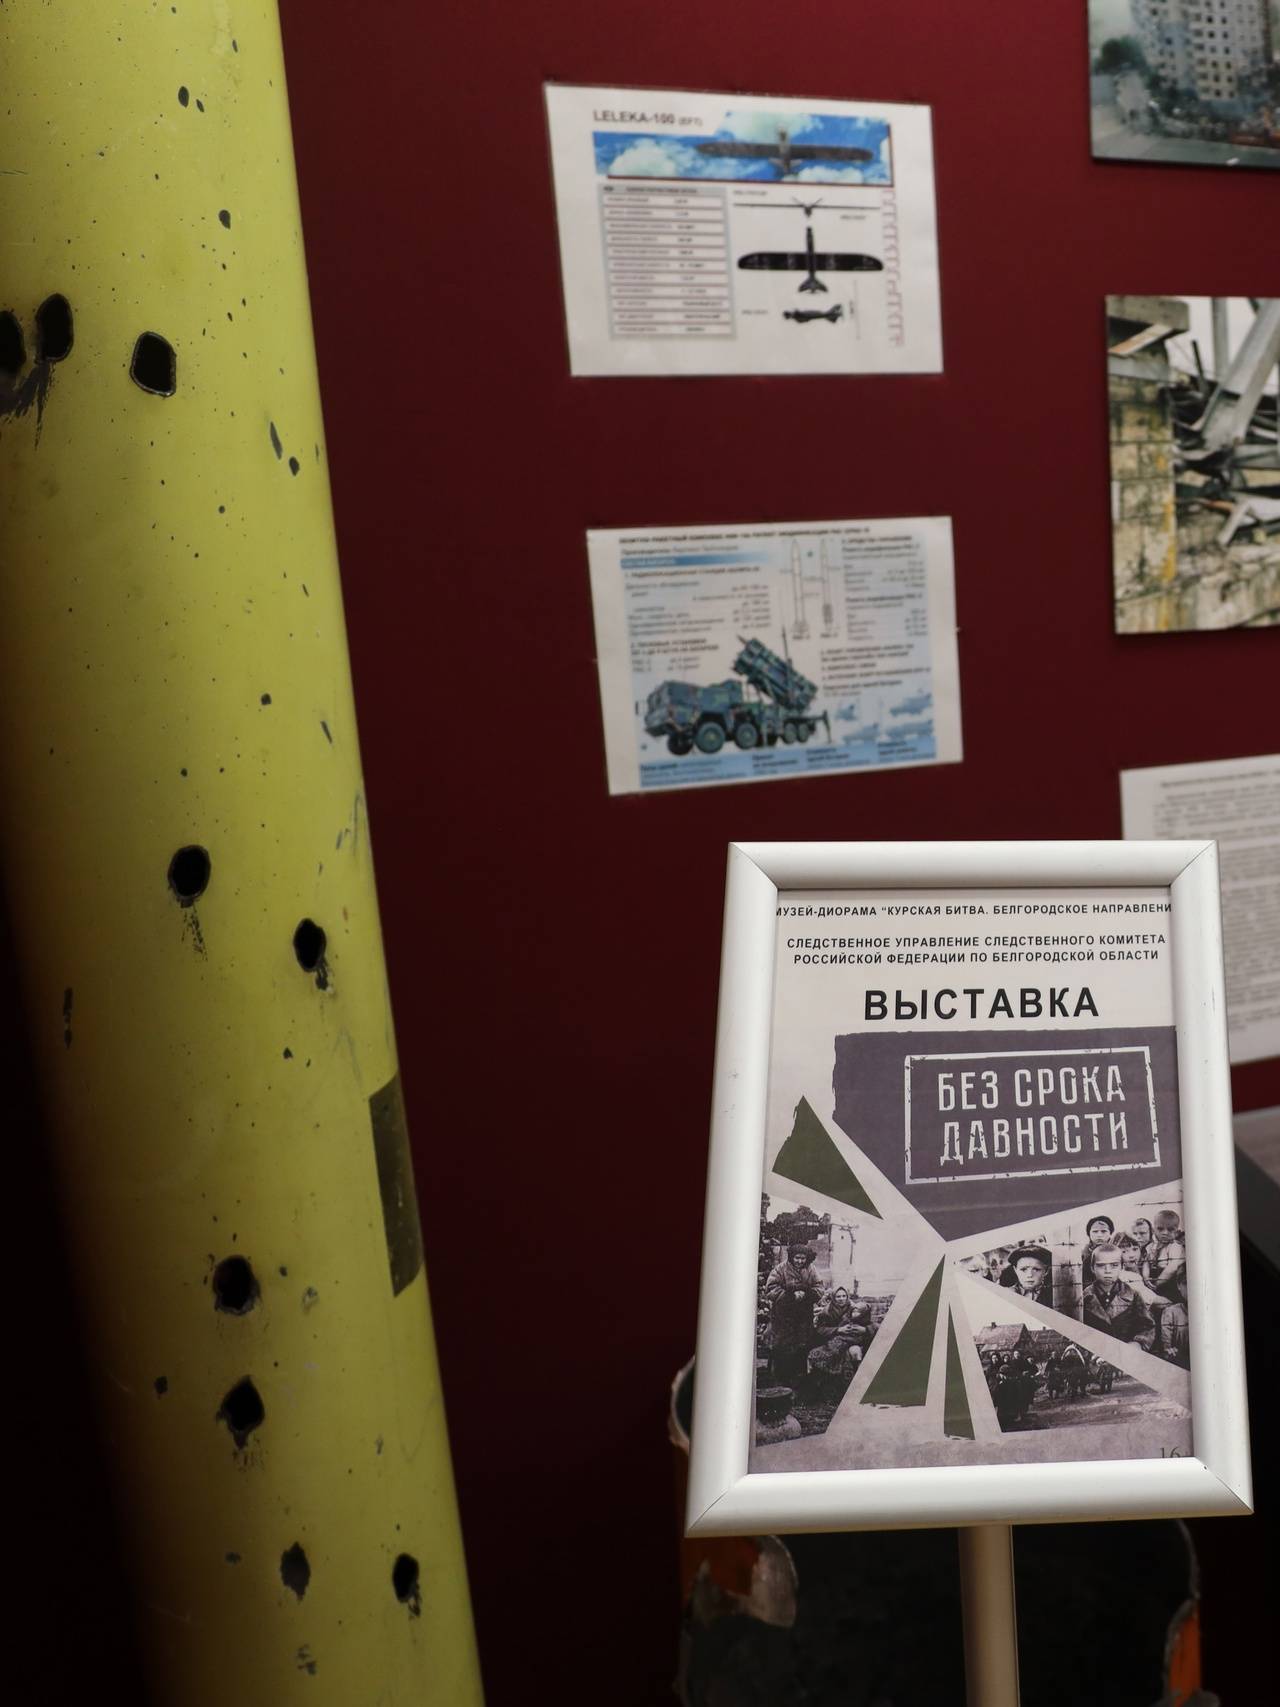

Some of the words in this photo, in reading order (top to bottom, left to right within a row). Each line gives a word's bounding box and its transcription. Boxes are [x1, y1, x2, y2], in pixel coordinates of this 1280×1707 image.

[593, 110, 674, 125] LELEKA-100
[945, 905, 988, 915] БИТВА.
[993, 904, 1088, 916] БЕЛГОРОДСКОЕ
[1092, 903, 1171, 913] НАПРАВЛЕНИ
[787, 937, 890, 950] СЛЕДСТВЕННОЕ
[895, 936, 979, 948] УПРАВЛЕНИЕ
[984, 935, 1095, 948] СЛЕДСТВЕННОГО
[1099, 934, 1166, 945] КОМИТЕТА
[794, 951, 882, 965] РОССИЙСКОЙ
[886, 952, 965, 965] ФЕДЕРАЦИИ
[970, 952, 988, 963] ПО
[992, 950, 1094, 963] БЕЛГОРОДСКОЙ
[1099, 950, 1158, 961] ОБЛАСТИ
[864, 987, 1099, 1021] ВЫСТАВКА
[938, 1070, 999, 1111] БЕЗ
[1014, 1065, 1126, 1107] СРОКА
[939, 1111, 1129, 1167] ДАВНОСТИ
